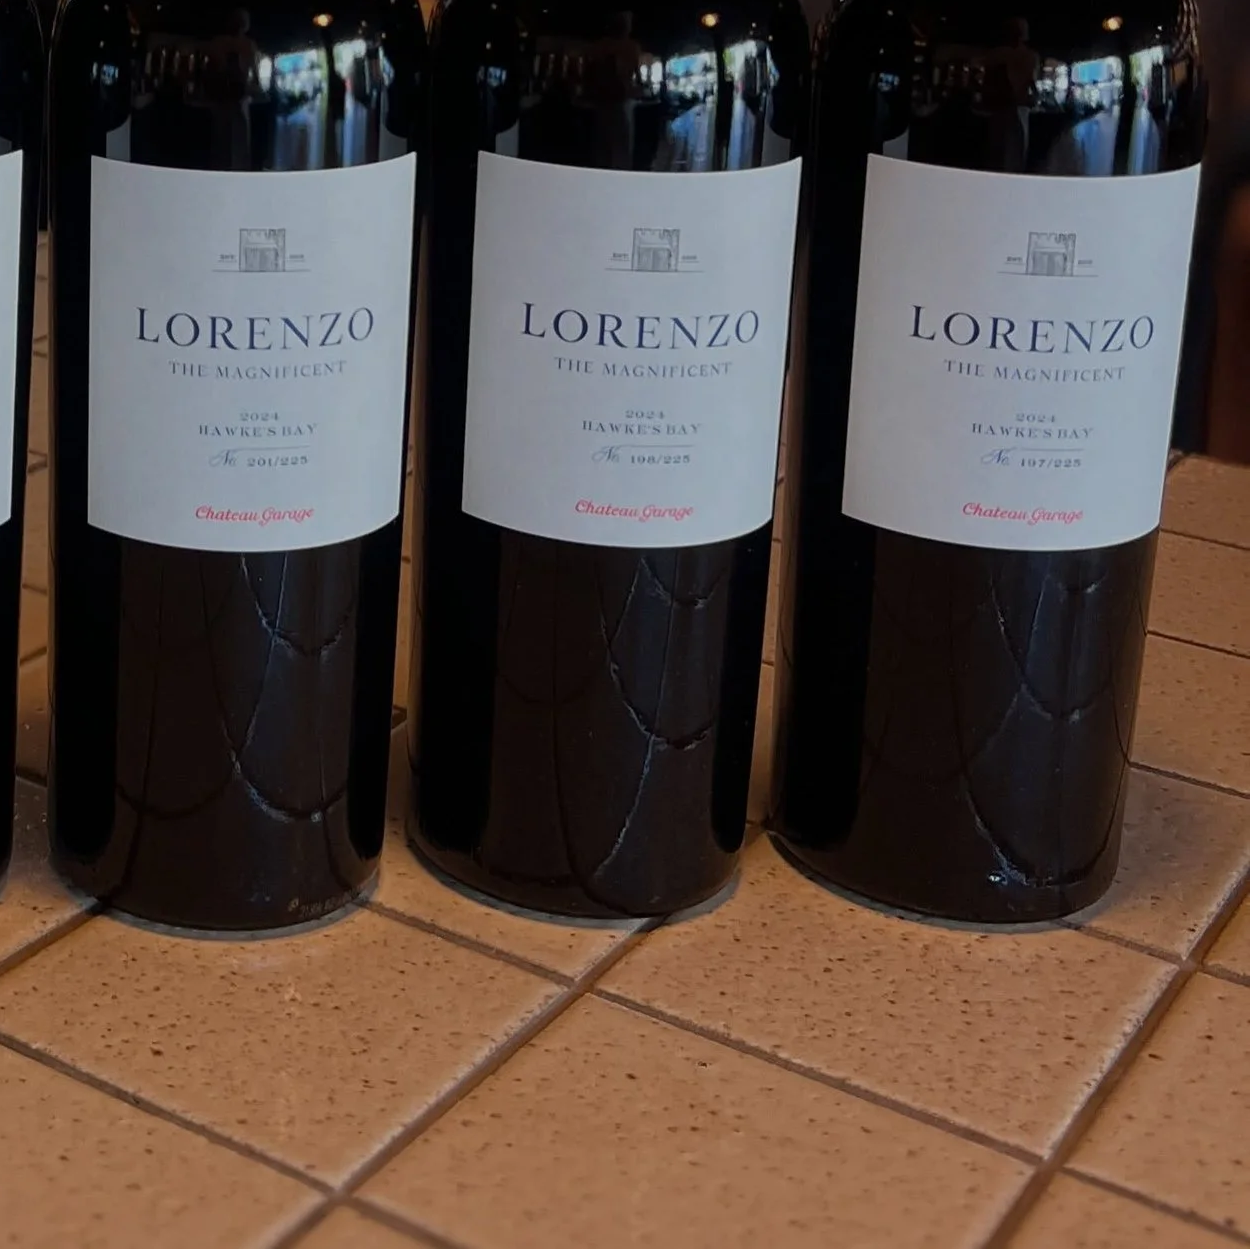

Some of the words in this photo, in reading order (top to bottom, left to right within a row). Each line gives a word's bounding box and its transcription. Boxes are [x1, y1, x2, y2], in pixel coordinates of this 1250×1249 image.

[137, 306, 374, 350] LORENZO
[523, 302, 759, 349] LORENZO
[911, 304, 1153, 353] LORENZO
[168, 361, 208, 377] THE
[214, 359, 346, 380] MAGNIFICENT
[554, 356, 595, 375] THE
[601, 362, 731, 378] MAGNIFICENT
[943, 359, 985, 377] THE
[993, 365, 1124, 383] MAGNIFICENT
[238, 411, 280, 423] 2024
[624, 409, 666, 420] 2024
[1014, 413, 1057, 424] 2024
[198, 424, 278, 438] HAWKE'S
[281, 422, 318, 437] BAY
[581, 420, 662, 436] HAWKE'S
[666, 422, 703, 436] BAY
[970, 423, 1053, 439] HAWKE'S
[1056, 427, 1095, 440] BAY
[195, 506, 259, 522] Chateau
[259, 507, 315, 526] Garage
[574, 499, 640, 520] Chateau
[639, 504, 694, 522] Garage
[962, 502, 1028, 521] Chateau
[1028, 507, 1084, 526] Garage
